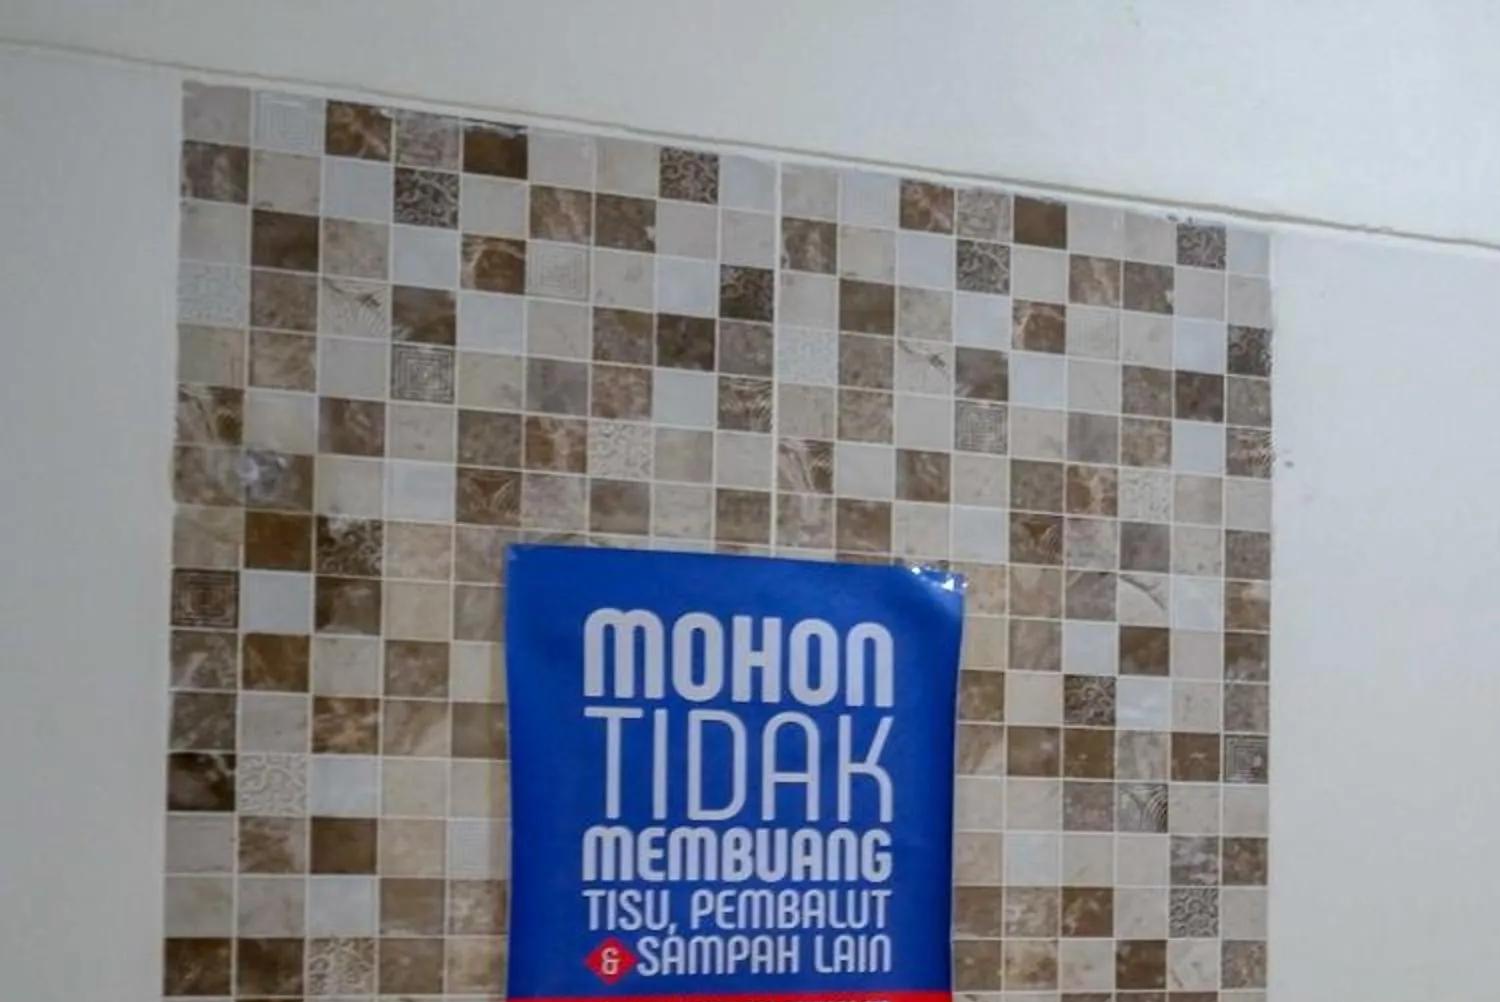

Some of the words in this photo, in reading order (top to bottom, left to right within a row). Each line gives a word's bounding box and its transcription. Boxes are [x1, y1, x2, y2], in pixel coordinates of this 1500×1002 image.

[583, 607, 894, 707] MOHON
[583, 706, 894, 823] TIDAK
[581, 825, 893, 883] MEMBUANG
[581, 889, 679, 935] TISU,
[690, 889, 893, 930] PEMBALUT
[600, 947, 620, 976] &
[635, 935, 800, 977] SAMPAH
[814, 934, 892, 974] LAIN
